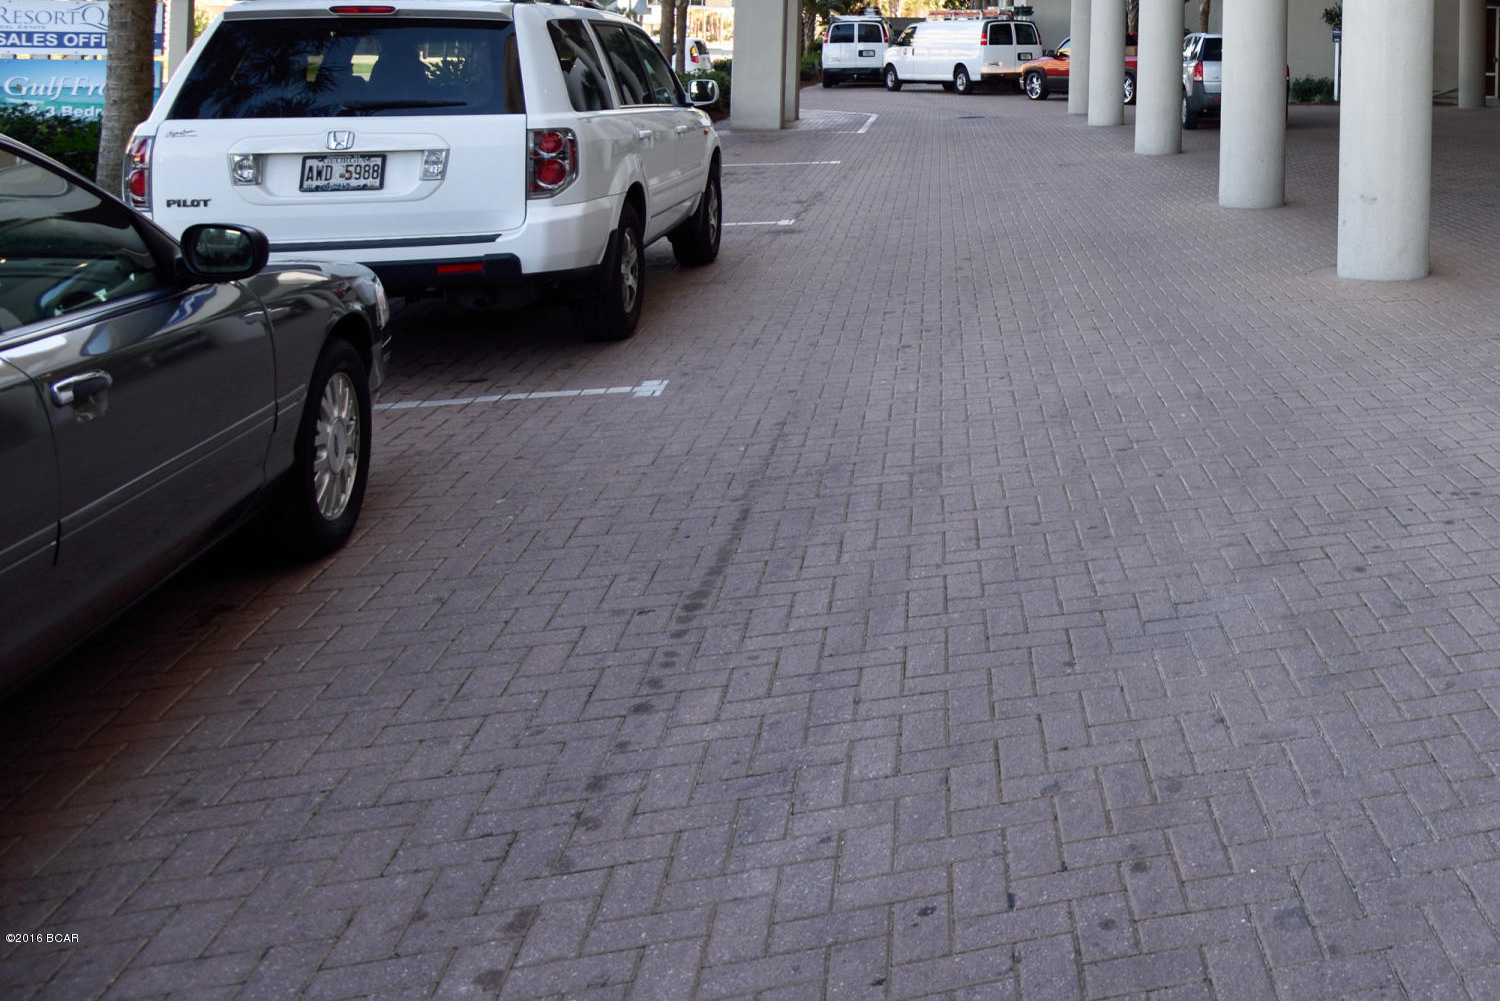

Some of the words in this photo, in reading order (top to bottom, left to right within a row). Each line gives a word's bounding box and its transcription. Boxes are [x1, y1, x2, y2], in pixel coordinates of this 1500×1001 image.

[63, 34, 106, 47] OFFI
[4, 76, 69, 101] Gulf
[62, 105, 103, 117] Bedr
[305, 165, 333, 182] AWD
[344, 164, 380, 180] 5988
[167, 199, 211, 207] PILOT
